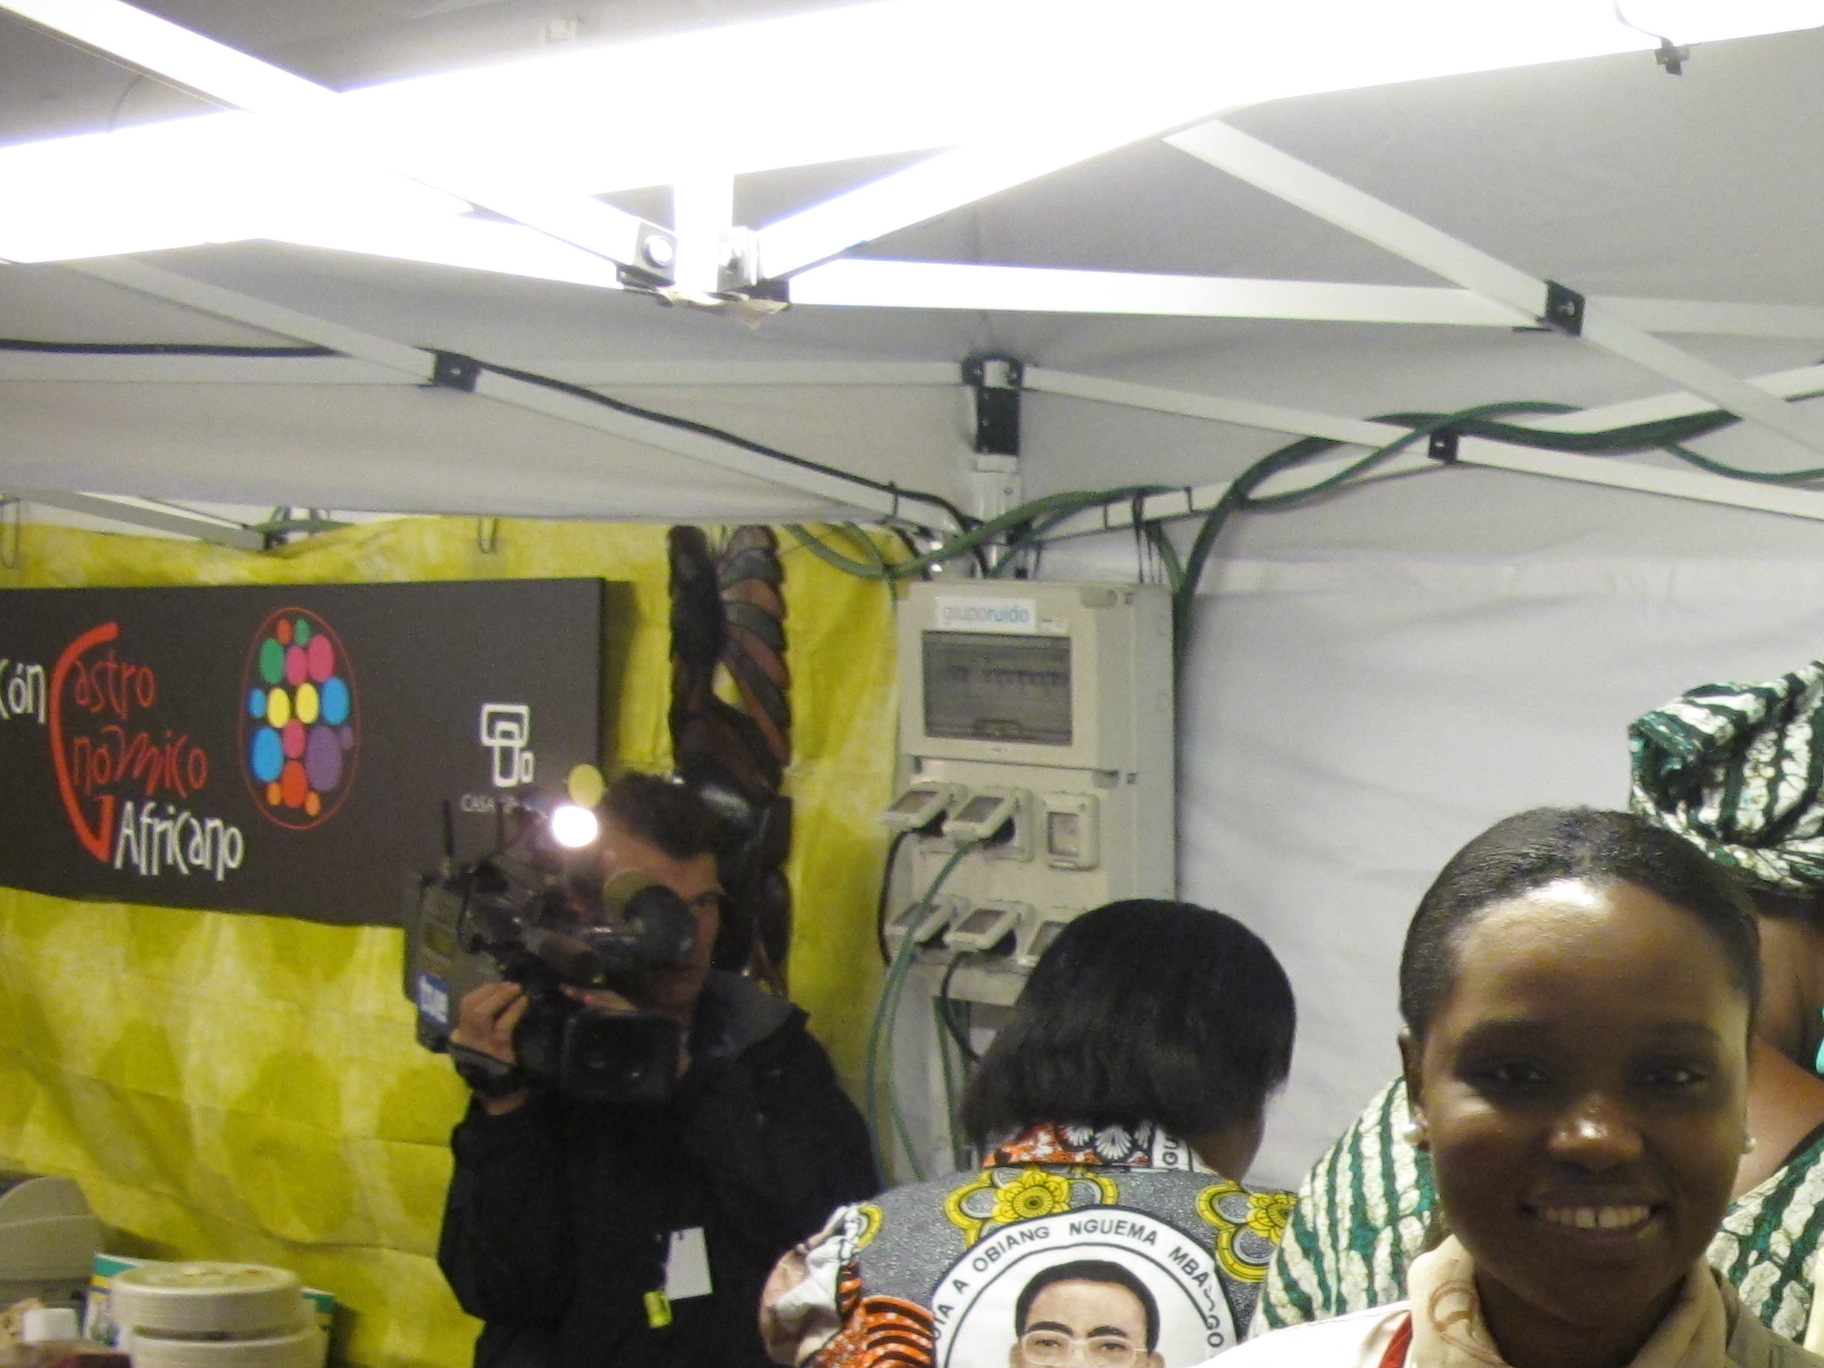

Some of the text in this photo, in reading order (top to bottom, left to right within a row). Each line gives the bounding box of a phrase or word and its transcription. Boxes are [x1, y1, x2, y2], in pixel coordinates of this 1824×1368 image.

[114, 800, 244, 882] Africano
[953, 1279, 969, 1295] A
[971, 1225, 1051, 1273] OBIANG
[1068, 1218, 1158, 1247] NGUEMA
